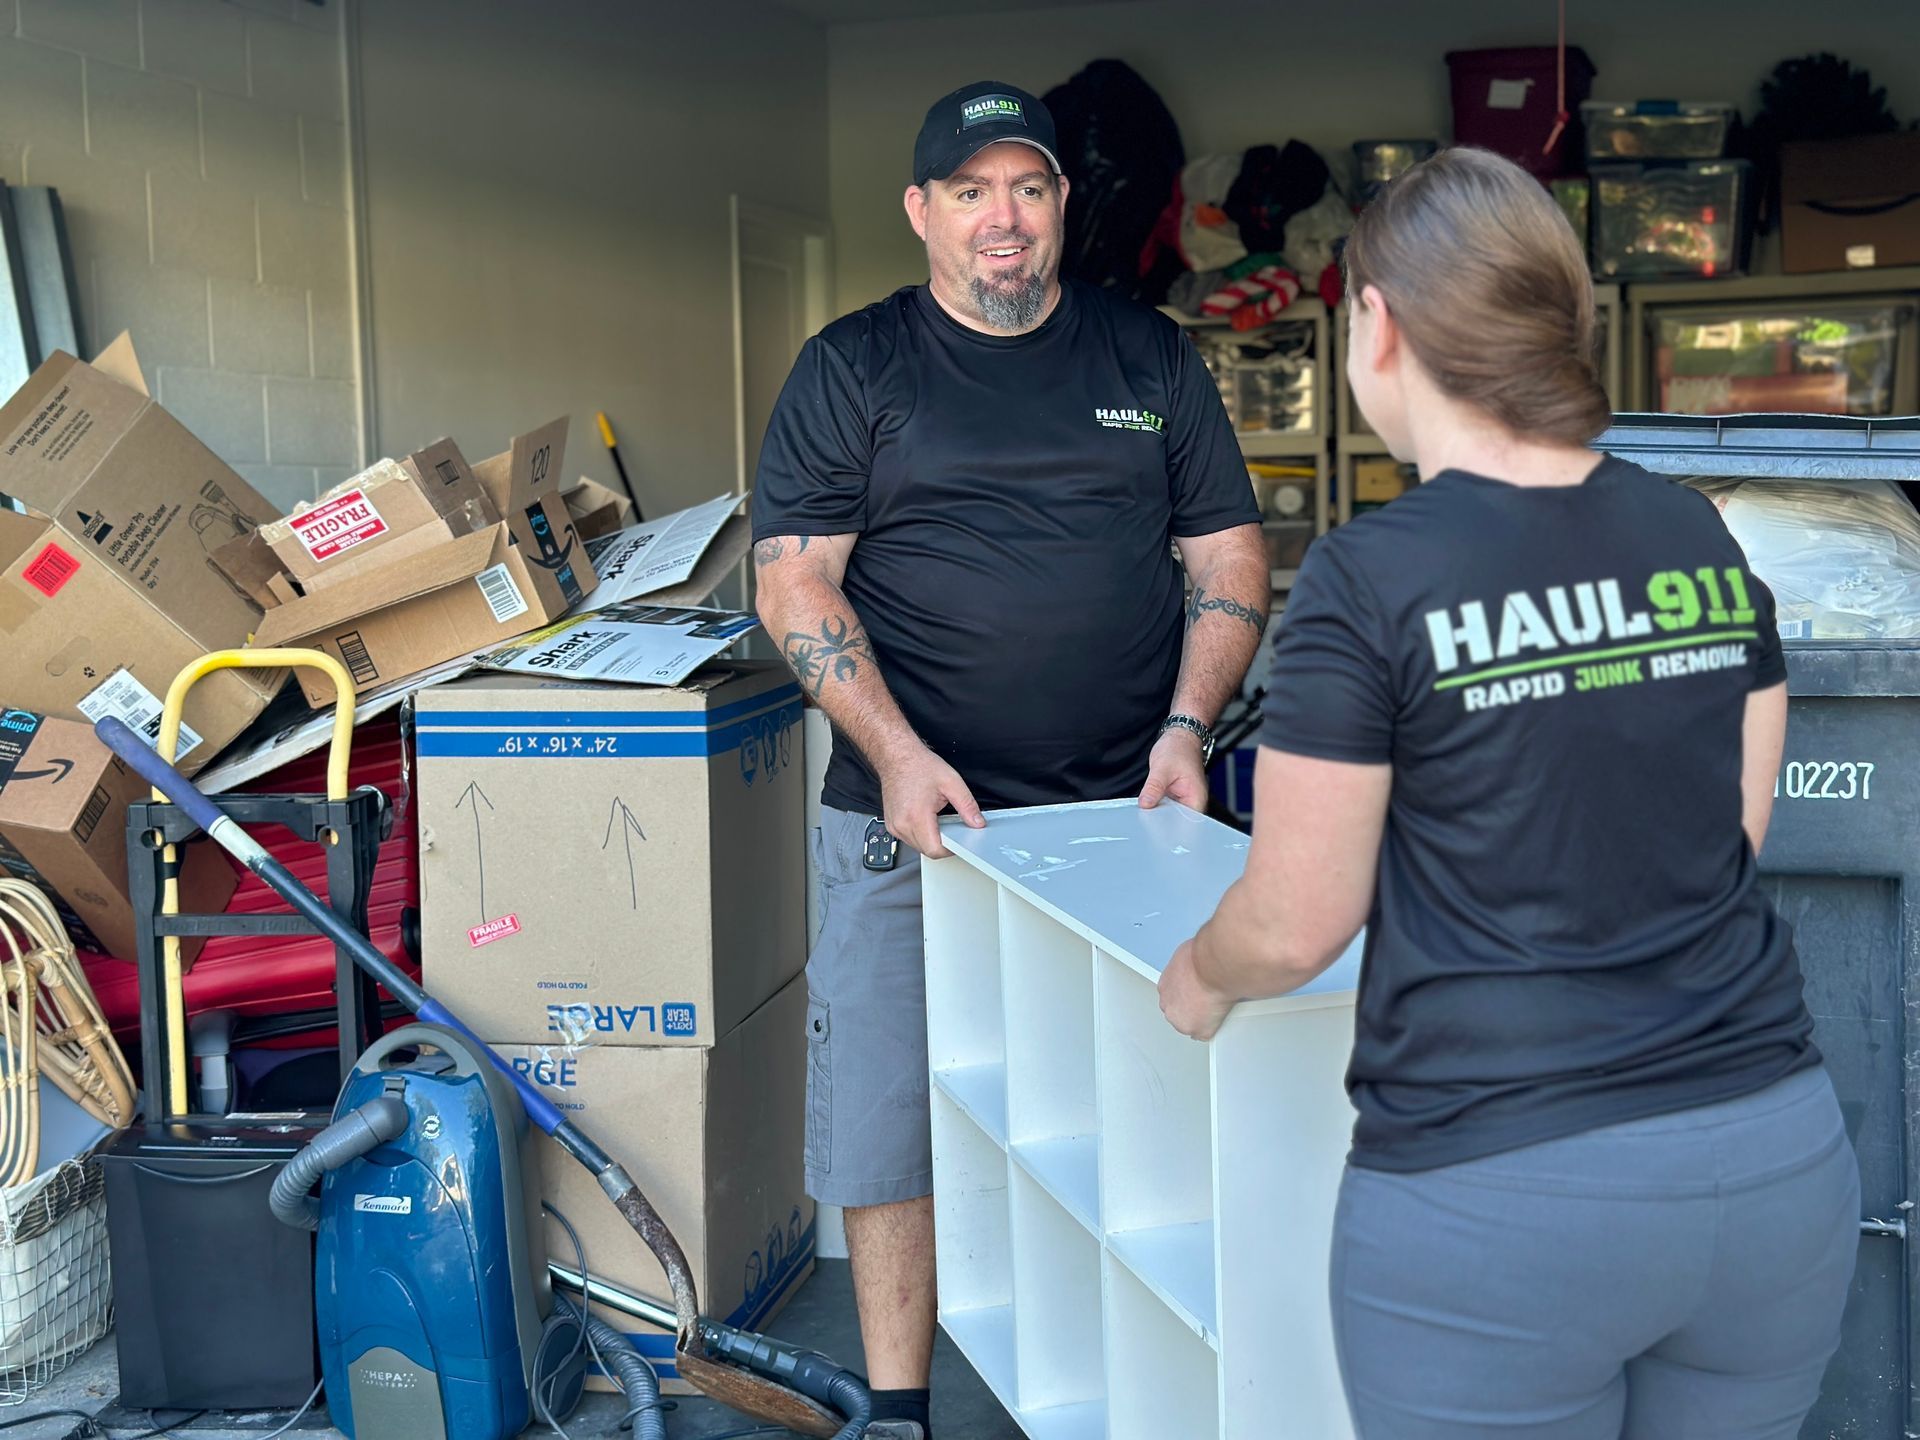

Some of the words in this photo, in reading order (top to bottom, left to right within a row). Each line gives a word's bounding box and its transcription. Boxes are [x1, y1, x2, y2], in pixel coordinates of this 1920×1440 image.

[964, 100, 1021, 116] HAUL911
[531, 444, 550, 485] 120
[302, 503, 371, 543] FRAGILE
[106, 539, 124, 557] Little
[132, 512, 145, 525] Pro
[118, 540, 141, 567] Portable
[136, 525, 153, 542] Deep
[148, 504, 167, 527] Cleaner
[601, 533, 655, 581] Shark
[1424, 567, 1756, 673] HAUL911
[528, 630, 599, 668] Shark
[1463, 671, 1565, 712] RAPID
[1574, 660, 1644, 691] JUNK
[1650, 644, 1748, 680] REMOVAL
[0, 719, 36, 733] prime
[498, 737, 524, 753] 19"
[527, 737, 538, 748] x
[542, 737, 568, 753] 16"
[572, 737, 582, 748] x
[587, 737, 617, 753] 24"
[473, 917, 513, 938] FRAGILE
[537, 981, 557, 989] HOLD
[569, 982, 588, 990] FOLD
[667, 1008, 690, 1022] GEAR
[667, 1019, 693, 1031] pen+
[513, 1057, 577, 1087] RGE
[565, 1103, 585, 1111] HOLD
[363, 1201, 409, 1211] Kenmore
[369, 1371, 402, 1381] HEPA
